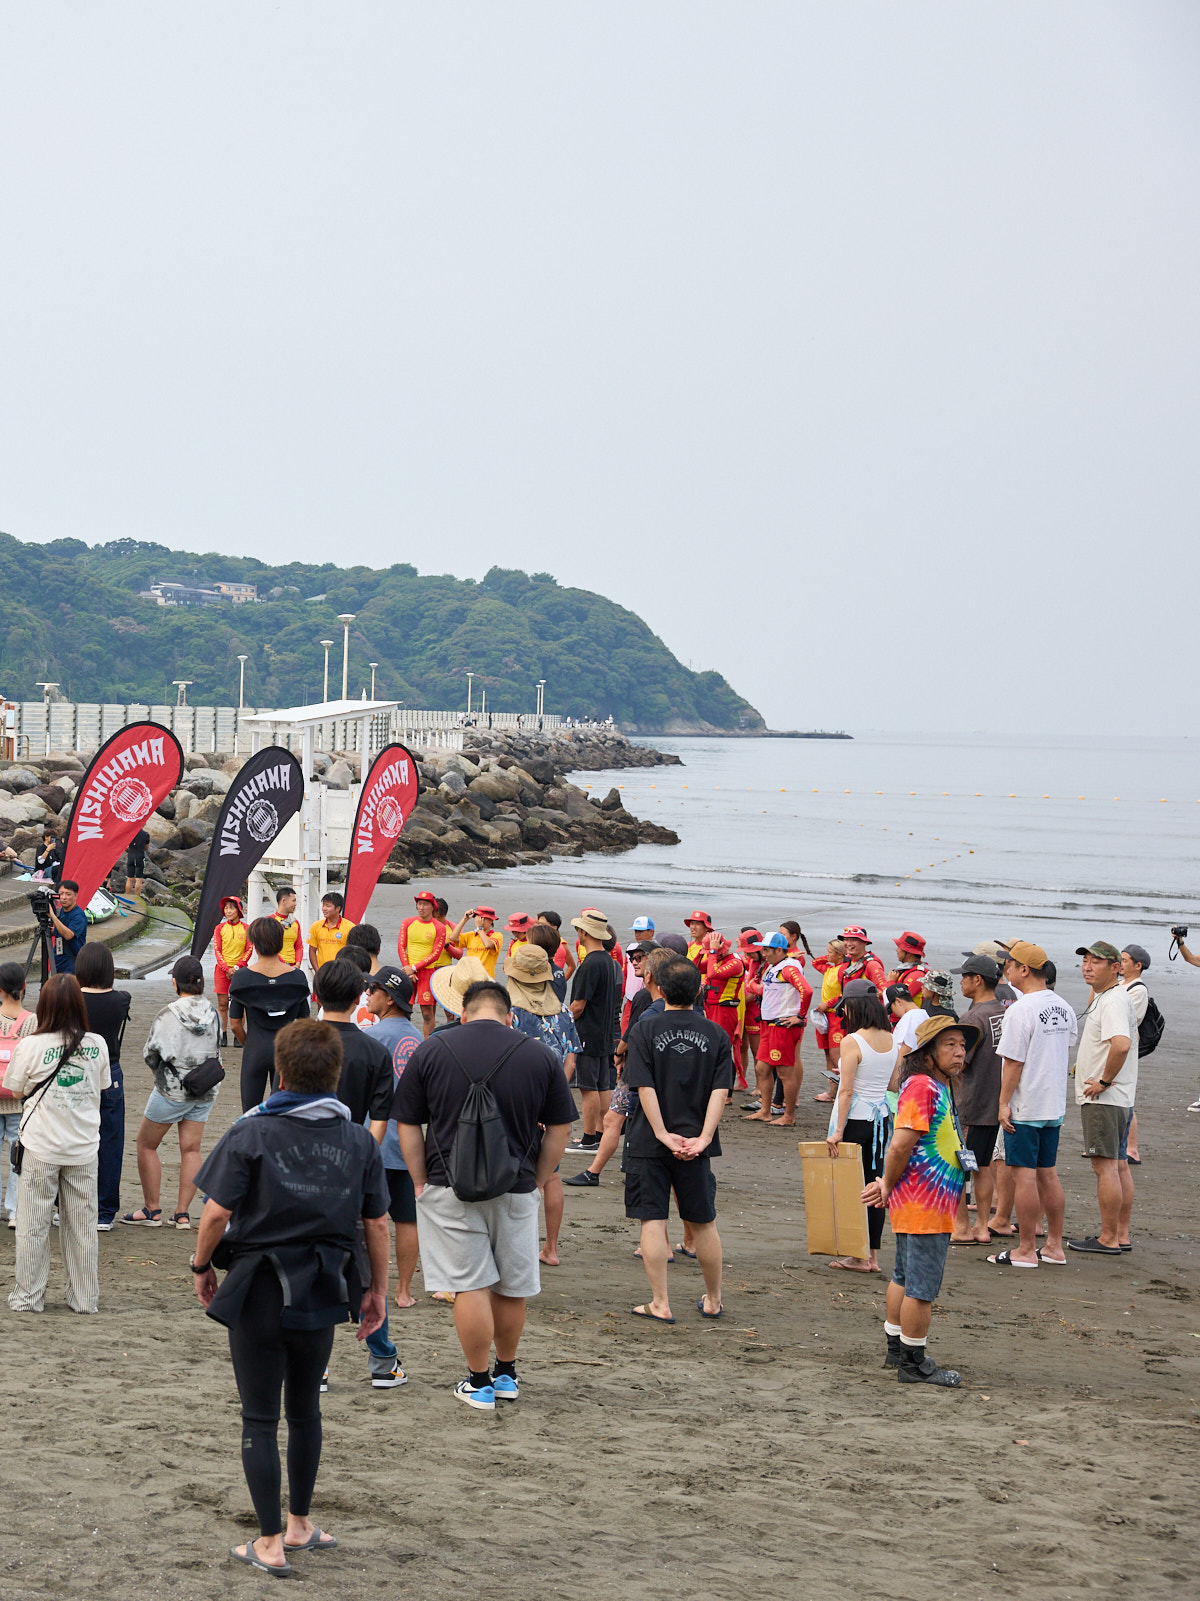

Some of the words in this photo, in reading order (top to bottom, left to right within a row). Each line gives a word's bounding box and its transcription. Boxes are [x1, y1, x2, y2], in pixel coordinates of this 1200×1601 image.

[77, 737, 165, 843] NISHIHAMA
[220, 764, 292, 856] NISHIHAMA
[358, 759, 409, 855] NISHIHAMA
[654, 1030, 709, 1052] BILLABONG
[1039, 1006, 1069, 1025] BILLABONG
